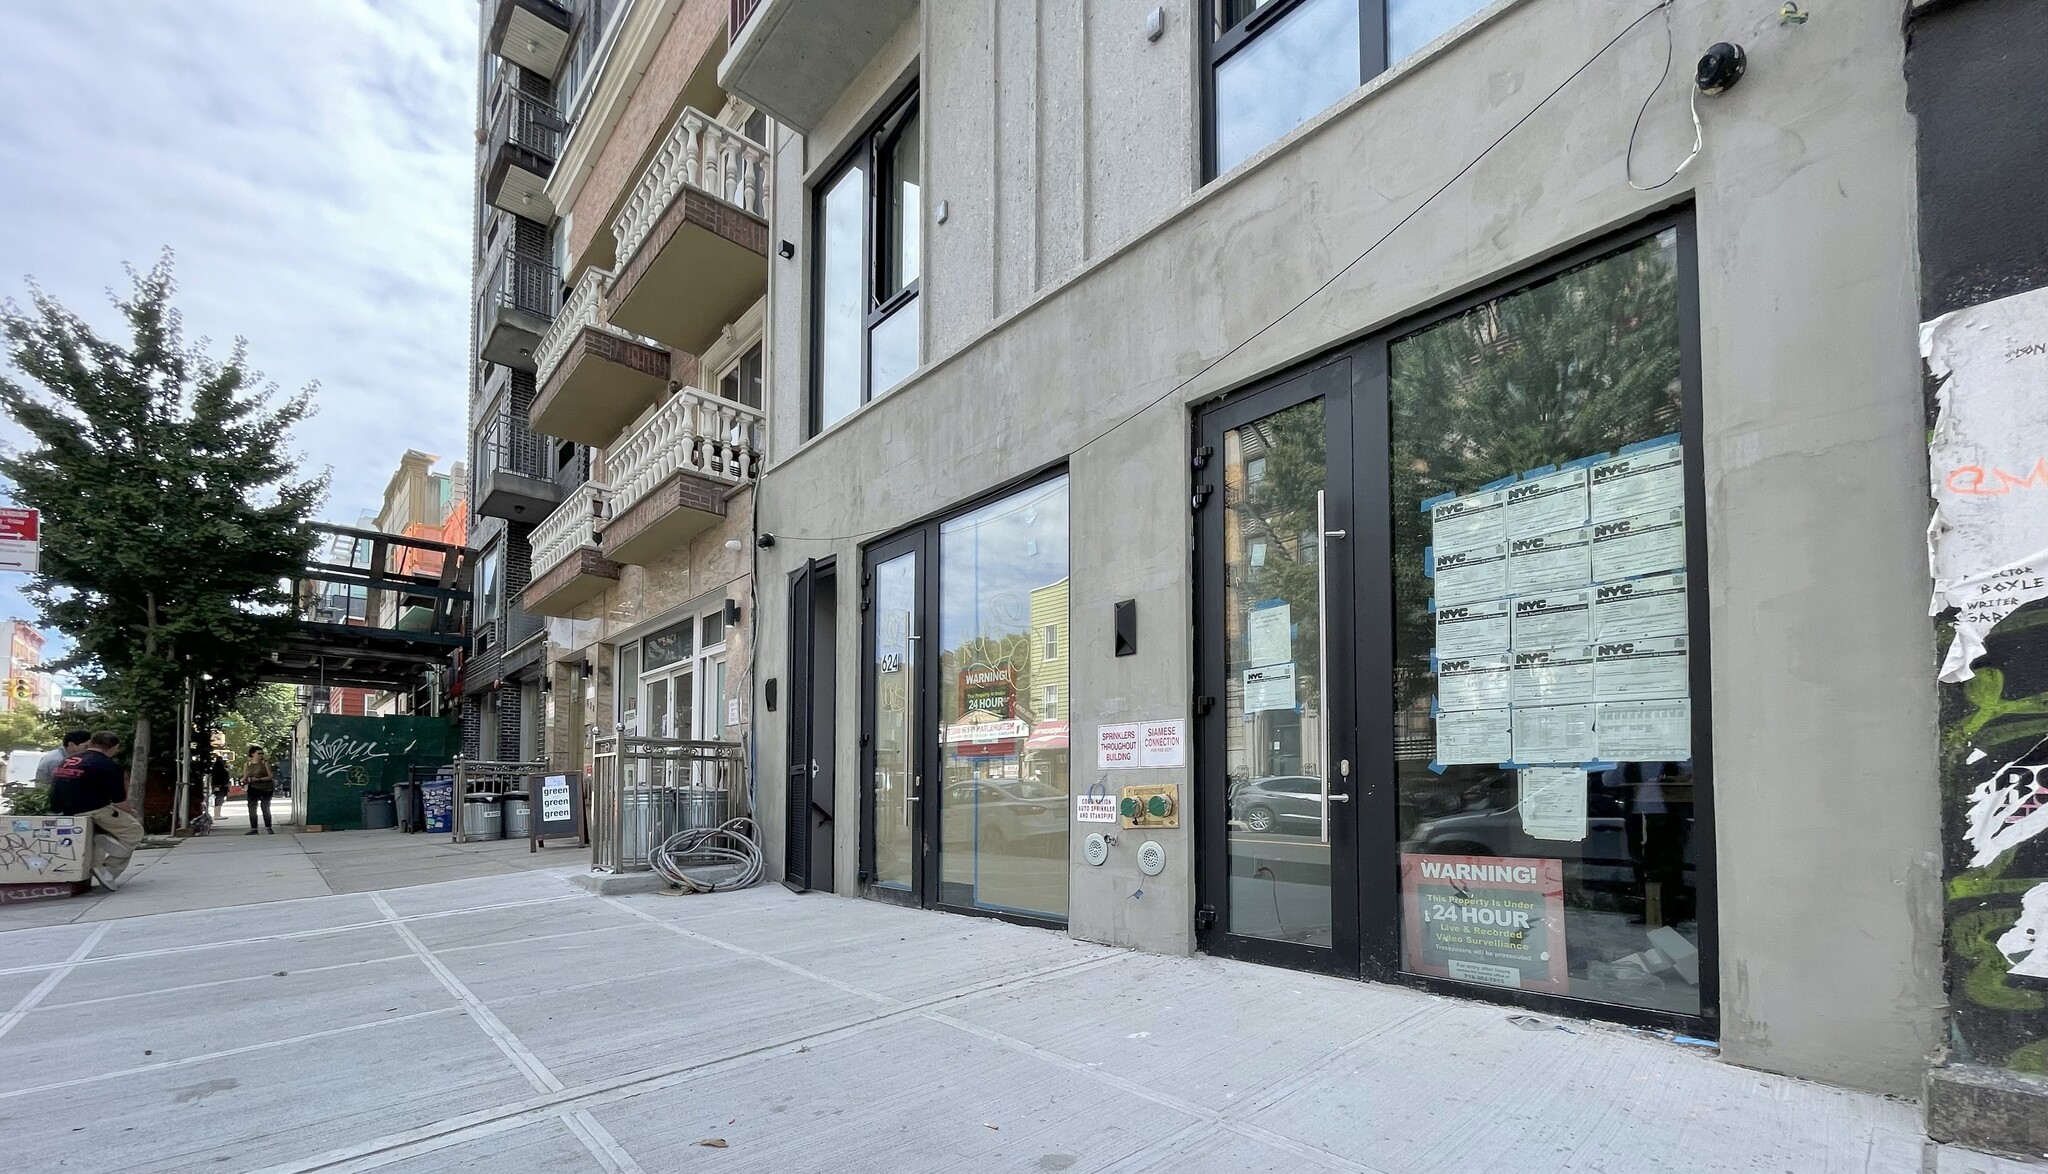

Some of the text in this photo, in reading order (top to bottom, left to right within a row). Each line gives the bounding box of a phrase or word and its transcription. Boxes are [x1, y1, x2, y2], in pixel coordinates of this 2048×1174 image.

[1594, 461, 1629, 479] NYC
[1509, 484, 1539, 500] NYC
[1436, 503, 1463, 517] NYC
[1595, 521, 1630, 537] NYC
[1512, 538, 1544, 551] NYC
[1437, 553, 1466, 566] NYC
[1597, 584, 1633, 598] NYC
[1518, 600, 1547, 611] NYC
[1967, 597, 2019, 610] WRITER
[1440, 608, 1468, 619] NYC
[1598, 643, 1634, 656] NYC
[882, 653, 898, 671] 624
[1516, 653, 1549, 664] NYC
[1442, 661, 1470, 672] NYC
[966, 670, 1008, 684] WARNING!
[968, 697, 1004, 710] 24 HOUR
[1102, 731, 1135, 741] SPRINKLERS
[1148, 727, 1176, 736] SIAMESE
[1101, 741, 1137, 751] THROUGHOUT
[1145, 737, 1179, 747] CONNECTION
[1106, 752, 1131, 762] BUILDING
[544, 787, 568, 796] green
[544, 799, 569, 807] green
[545, 810, 569, 819] green
[1420, 861, 1537, 884] WARNING!
[1427, 894, 1446, 902] This
[1449, 896, 1489, 908] Property
[1504, 900, 1534, 909] Under
[1432, 904, 1530, 929] 24 HOUR
[1435, 933, 1463, 943] Video
[1440, 924, 1460, 932] Live
[1473, 927, 1523, 939] Recorded
[1473, 948, 1484, 956] will
[1494, 951, 1532, 961] prosecuted
